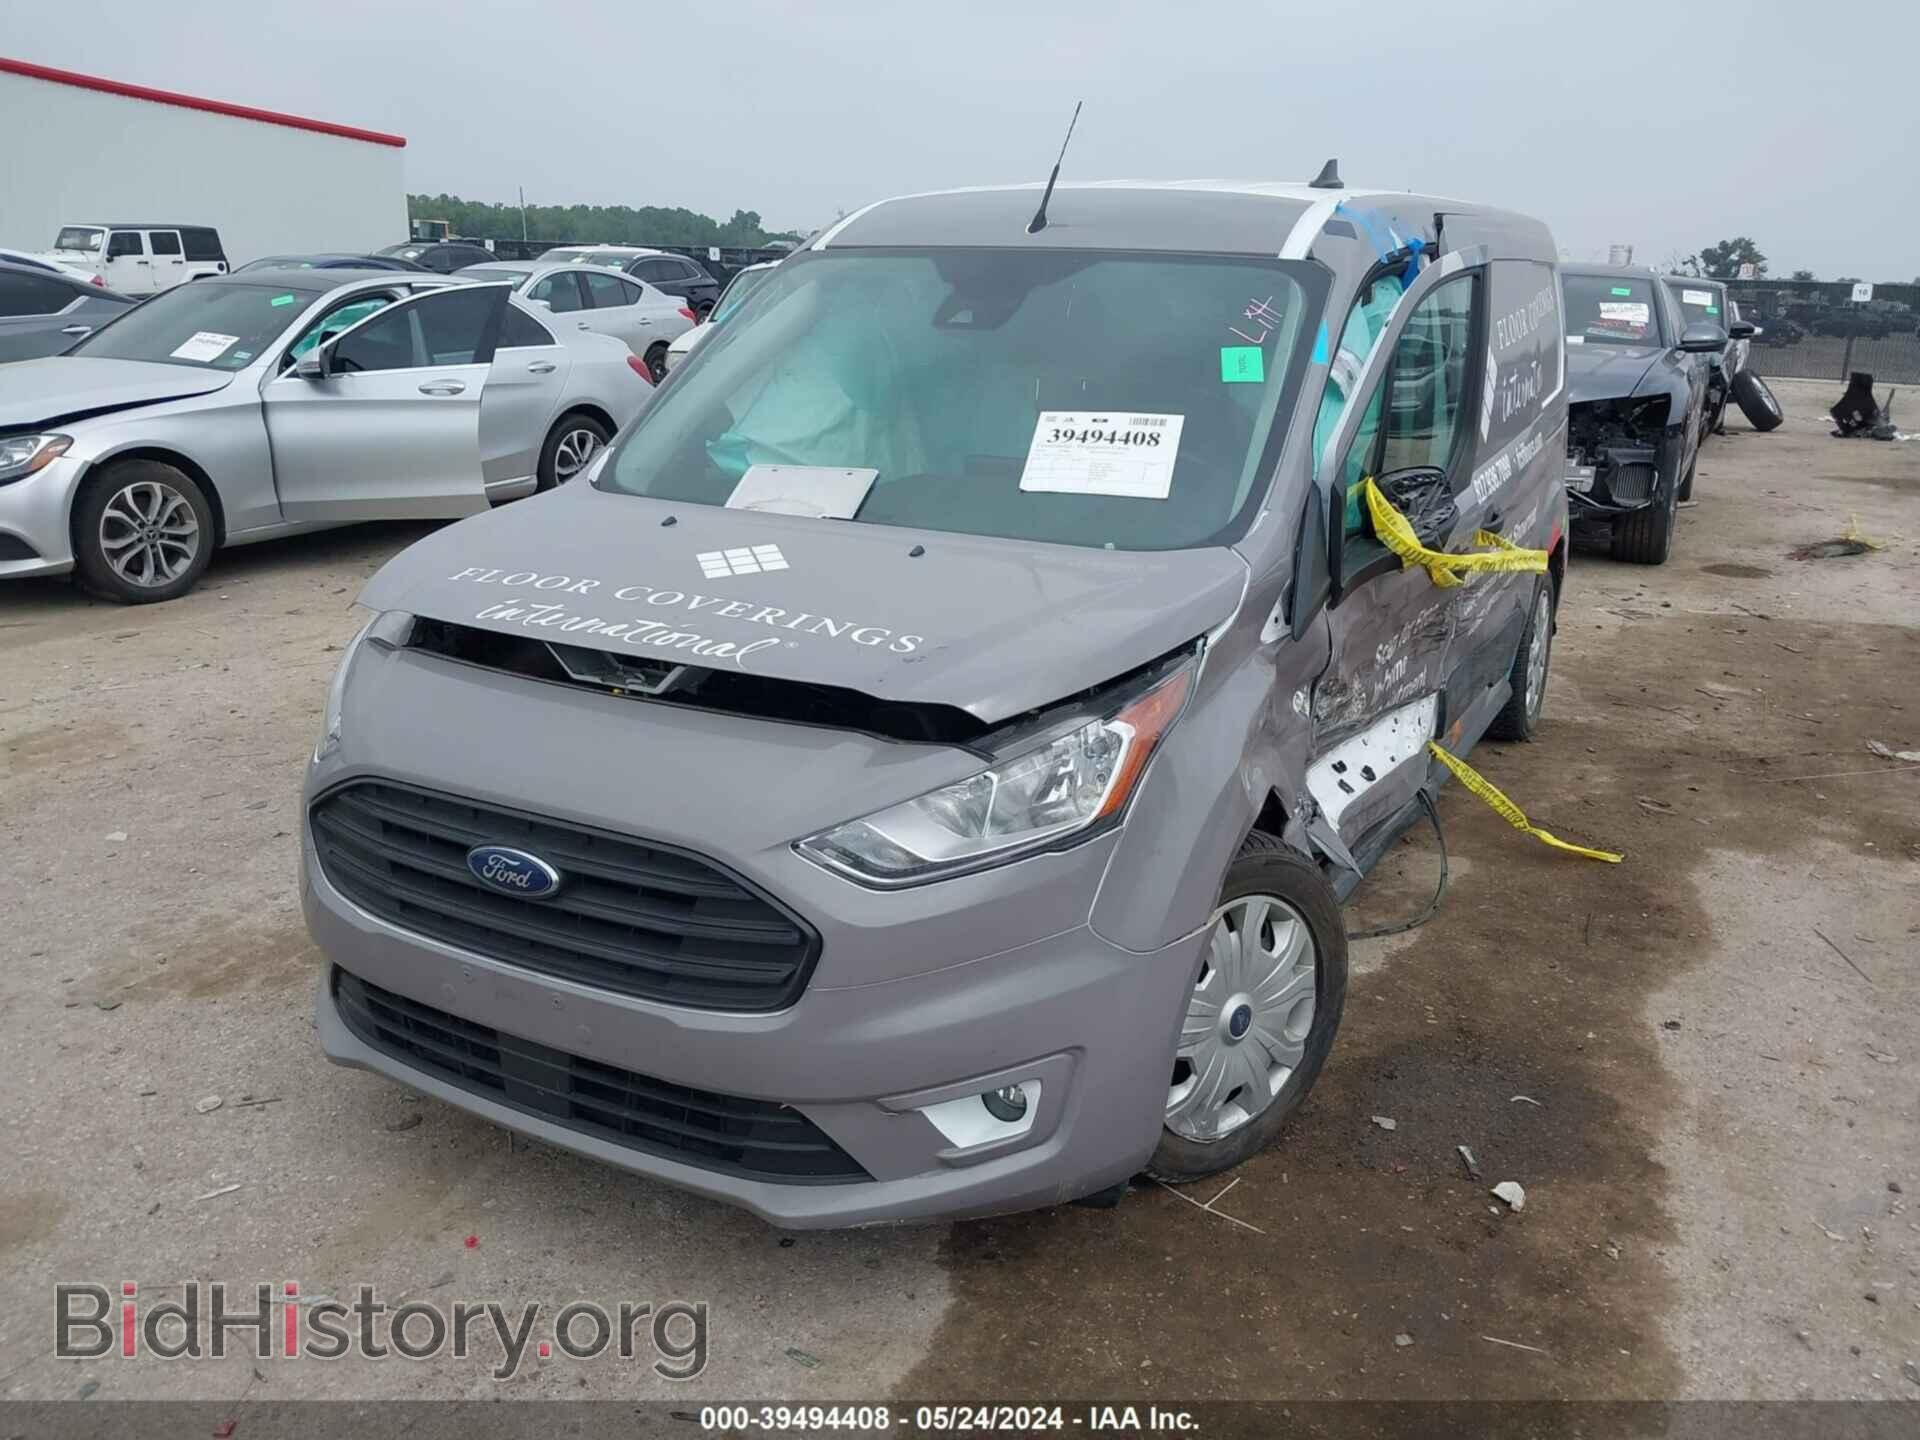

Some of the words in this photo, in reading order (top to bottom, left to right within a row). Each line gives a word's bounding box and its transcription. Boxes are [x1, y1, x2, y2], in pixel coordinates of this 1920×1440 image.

[1496, 308, 1528, 350] FLOOR
[1047, 428, 1161, 447] 39494408
[448, 566, 601, 595] FLOOR
[613, 585, 925, 654] COVERINGS
[475, 598, 782, 669] international
[482, 854, 534, 889] Ford
